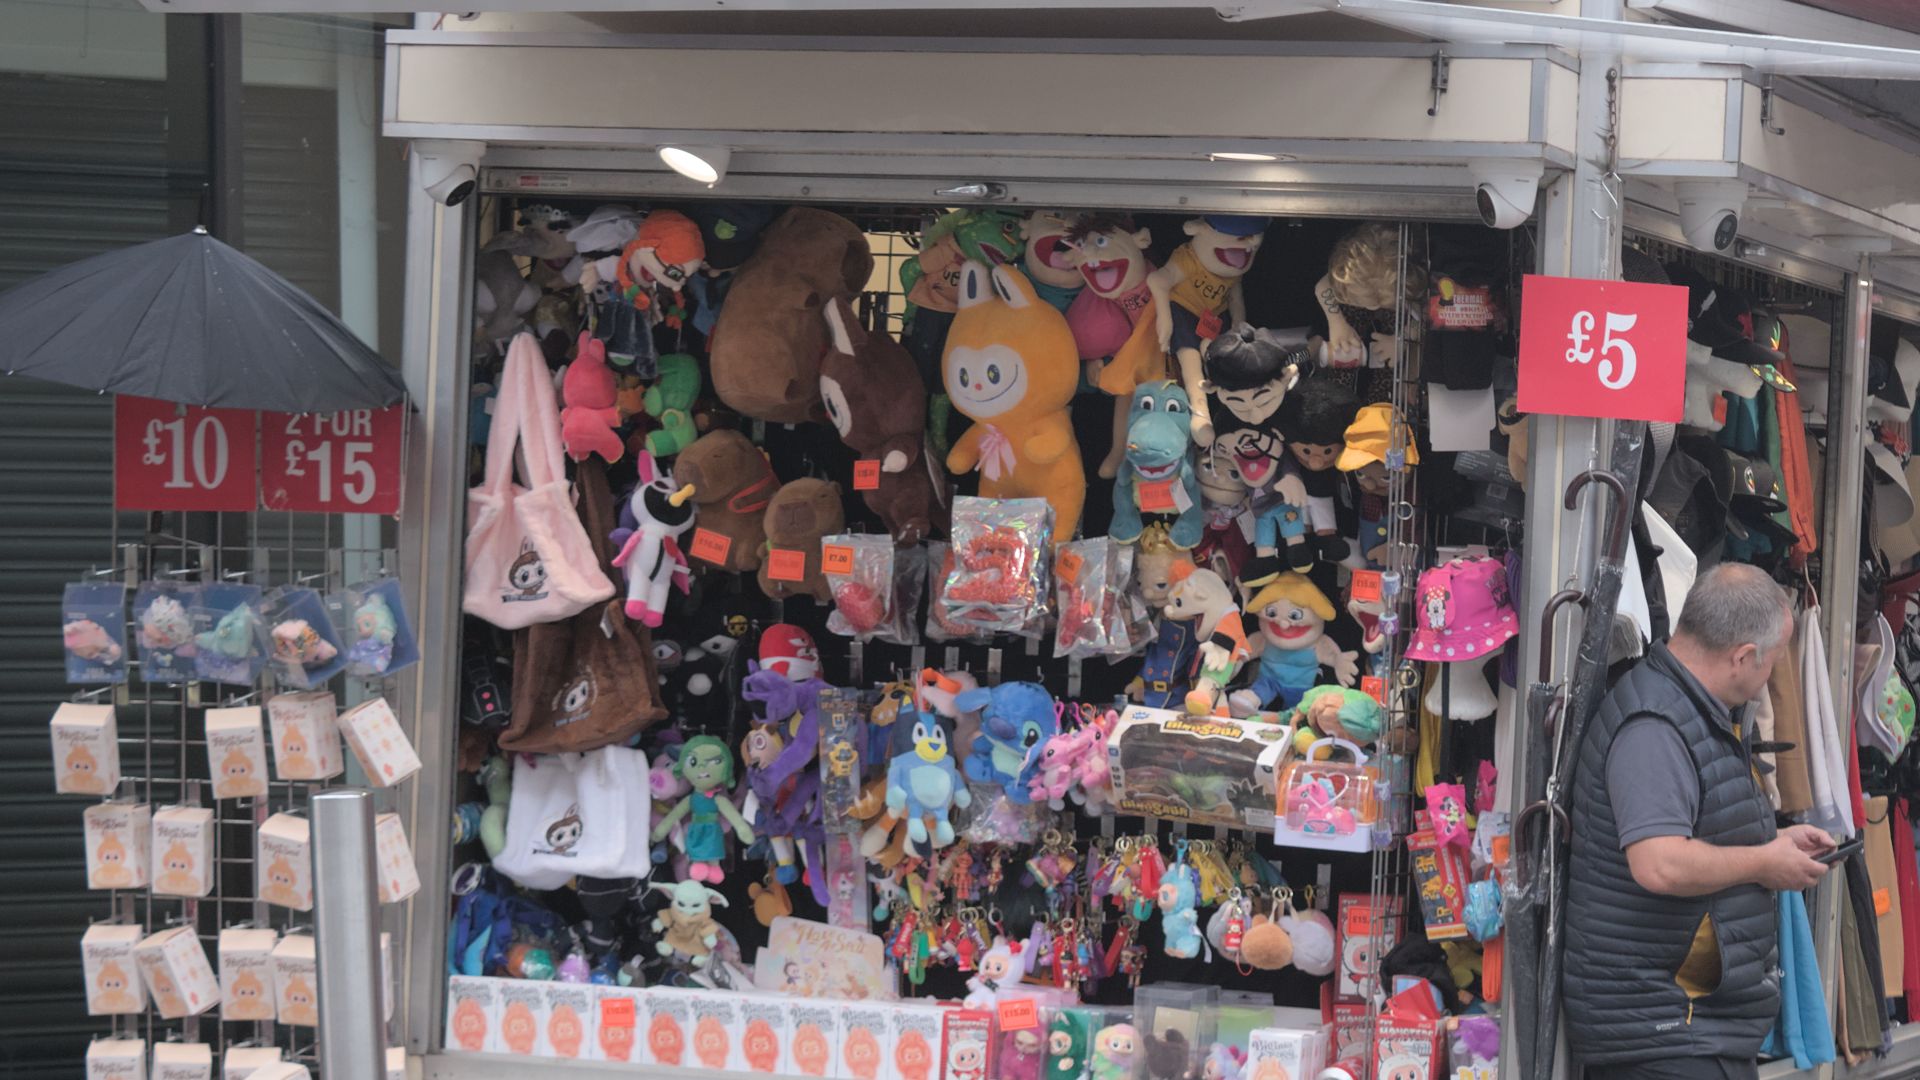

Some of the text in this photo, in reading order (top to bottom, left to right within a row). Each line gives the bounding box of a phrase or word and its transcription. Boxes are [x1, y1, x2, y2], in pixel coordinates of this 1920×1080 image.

[1565, 310, 1638, 390] £5
[285, 408, 372, 437] 2 FOR
[142, 415, 230, 490] £10
[285, 439, 377, 505] £15
[828, 554, 848, 563] £7.00
[1004, 1007, 1030, 1019] £15.00
